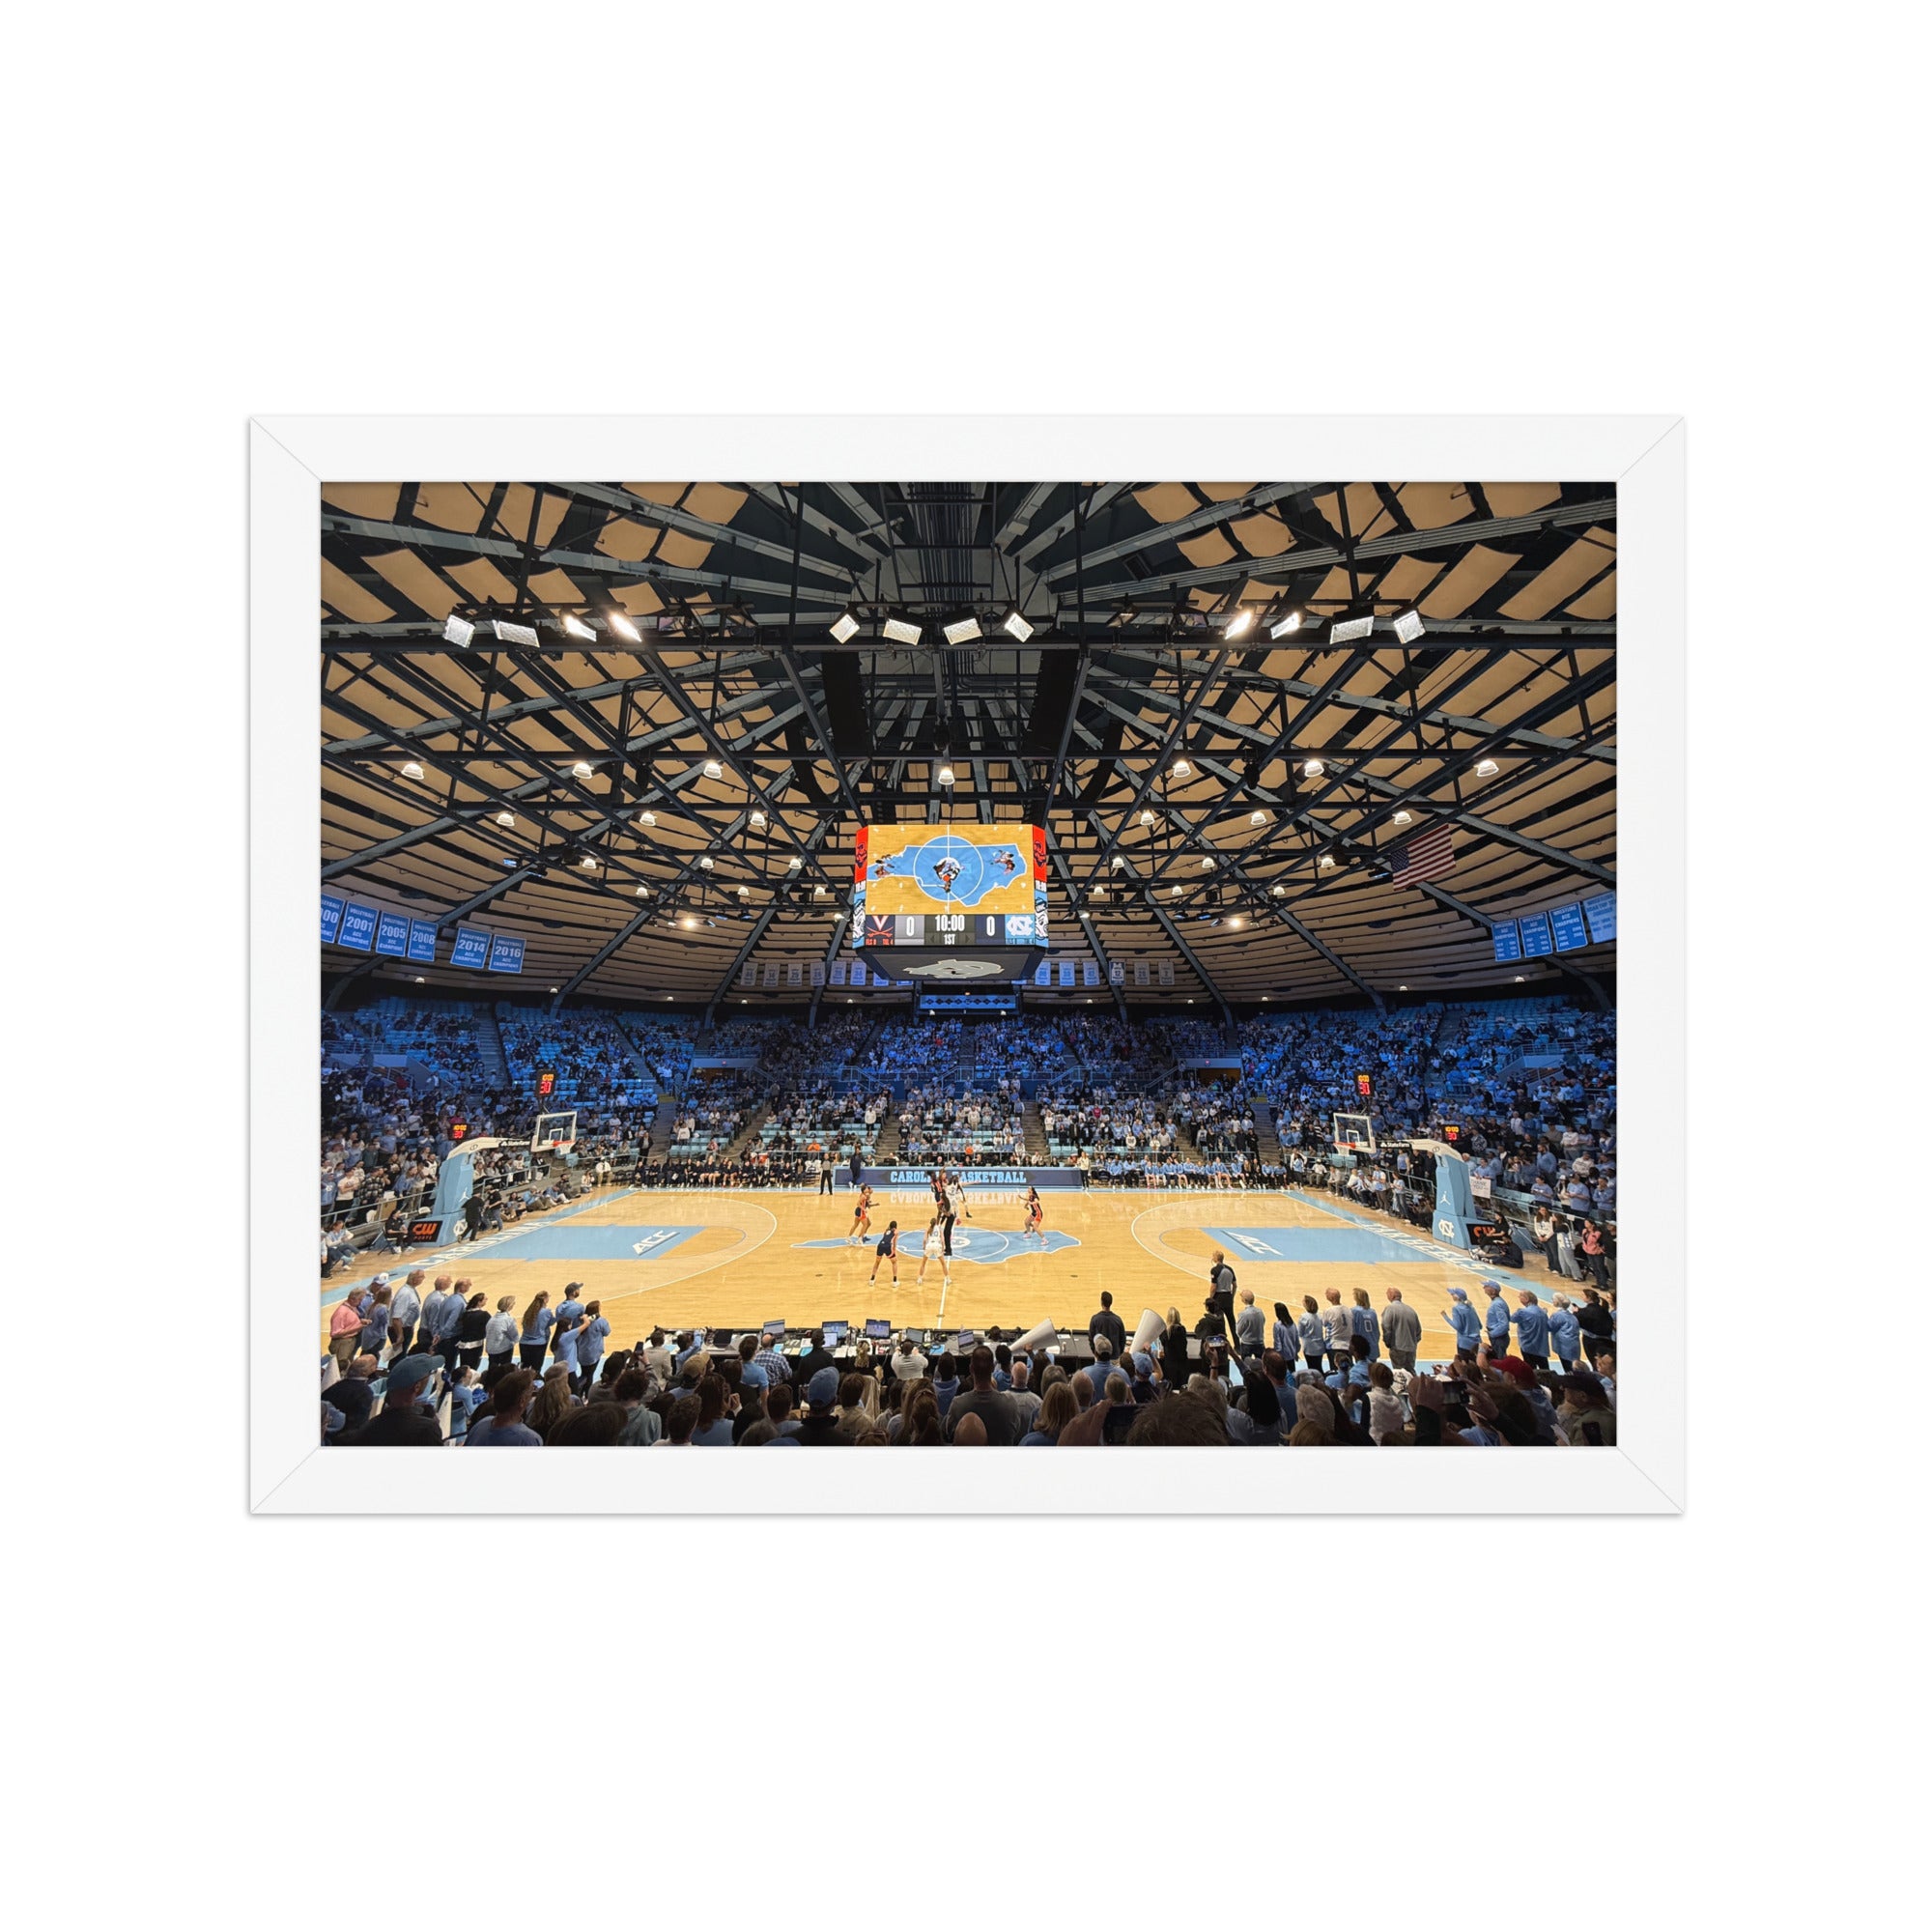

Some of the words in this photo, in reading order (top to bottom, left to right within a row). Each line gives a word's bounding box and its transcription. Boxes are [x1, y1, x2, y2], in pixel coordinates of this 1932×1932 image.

[321, 909, 339, 923] 00
[935, 914, 965, 932] 10:00
[347, 917, 372, 932] 2001
[382, 924, 406, 938] 2005
[906, 916, 915, 936] 0
[986, 916, 995, 936] 0
[412, 931, 435, 945] 2008
[944, 934, 956, 945] 1ST
[458, 939, 485, 952] 2014
[495, 946, 521, 957] 2016
[540, 1081, 552, 1094] 30
[1359, 1082, 1370, 1094] 30
[412, 1222, 438, 1236] CW
[633, 1230, 678, 1256] ACC
